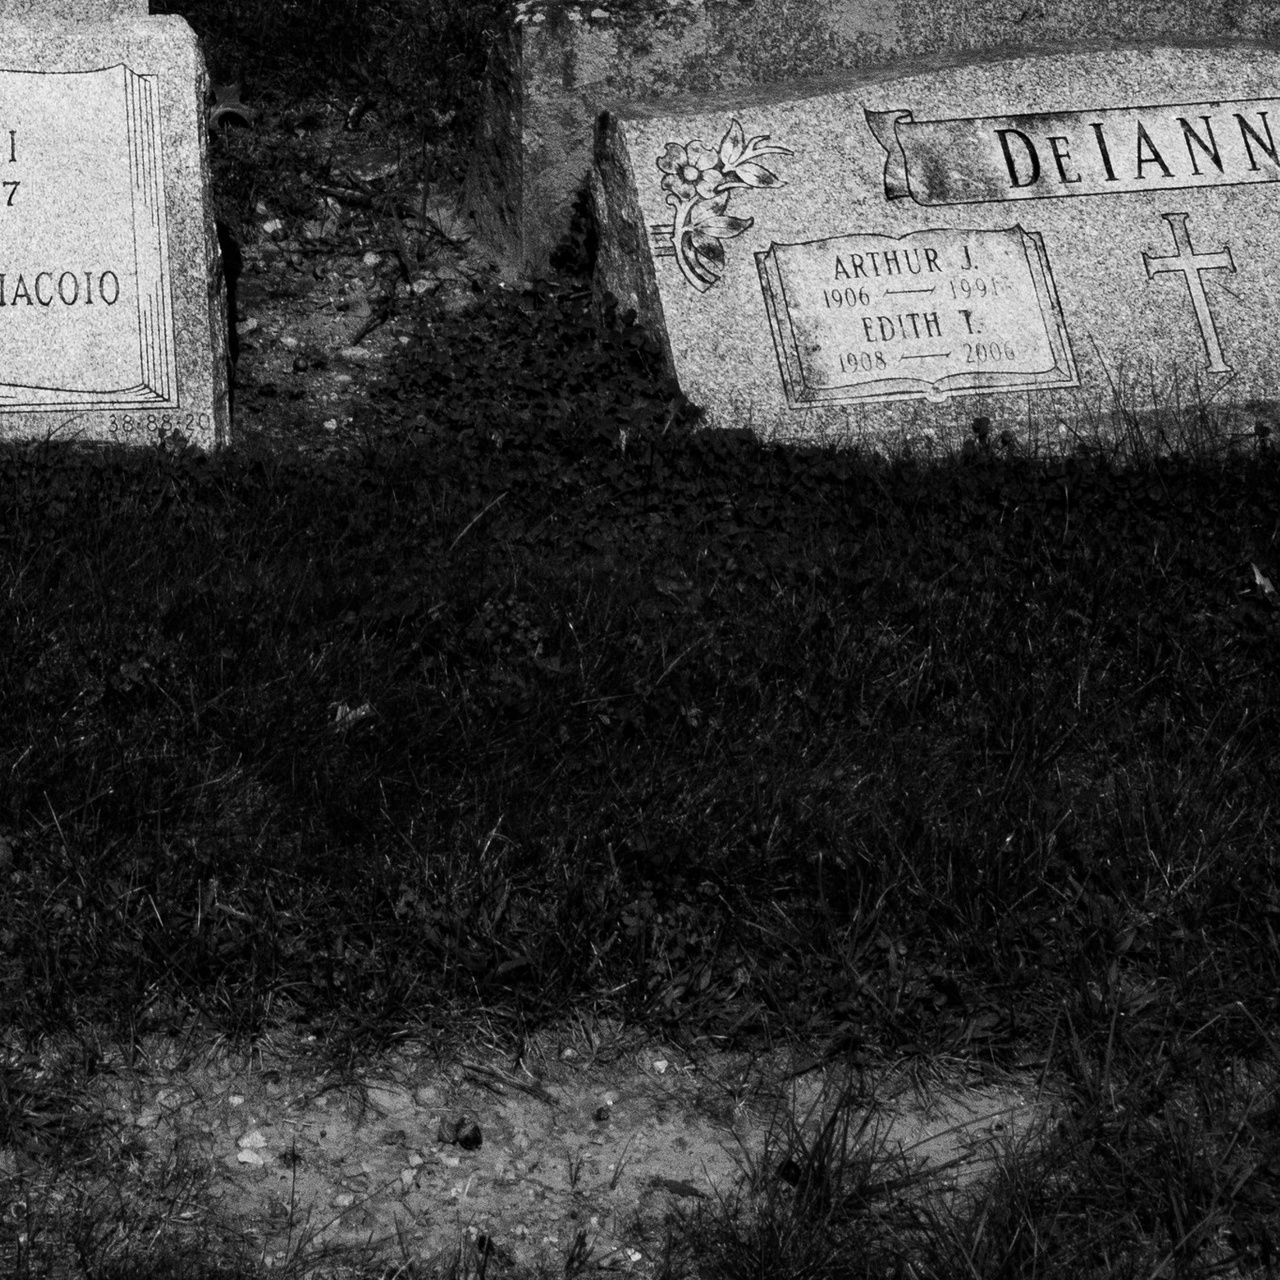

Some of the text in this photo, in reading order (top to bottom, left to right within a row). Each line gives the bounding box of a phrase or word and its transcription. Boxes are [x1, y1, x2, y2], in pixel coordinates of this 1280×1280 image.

[834, 245, 979, 281] ARTHUR J.
[823, 276, 999, 309] 1906 1991
[861, 311, 943, 343] EDITH
[838, 340, 1016, 374] 1908 2006
